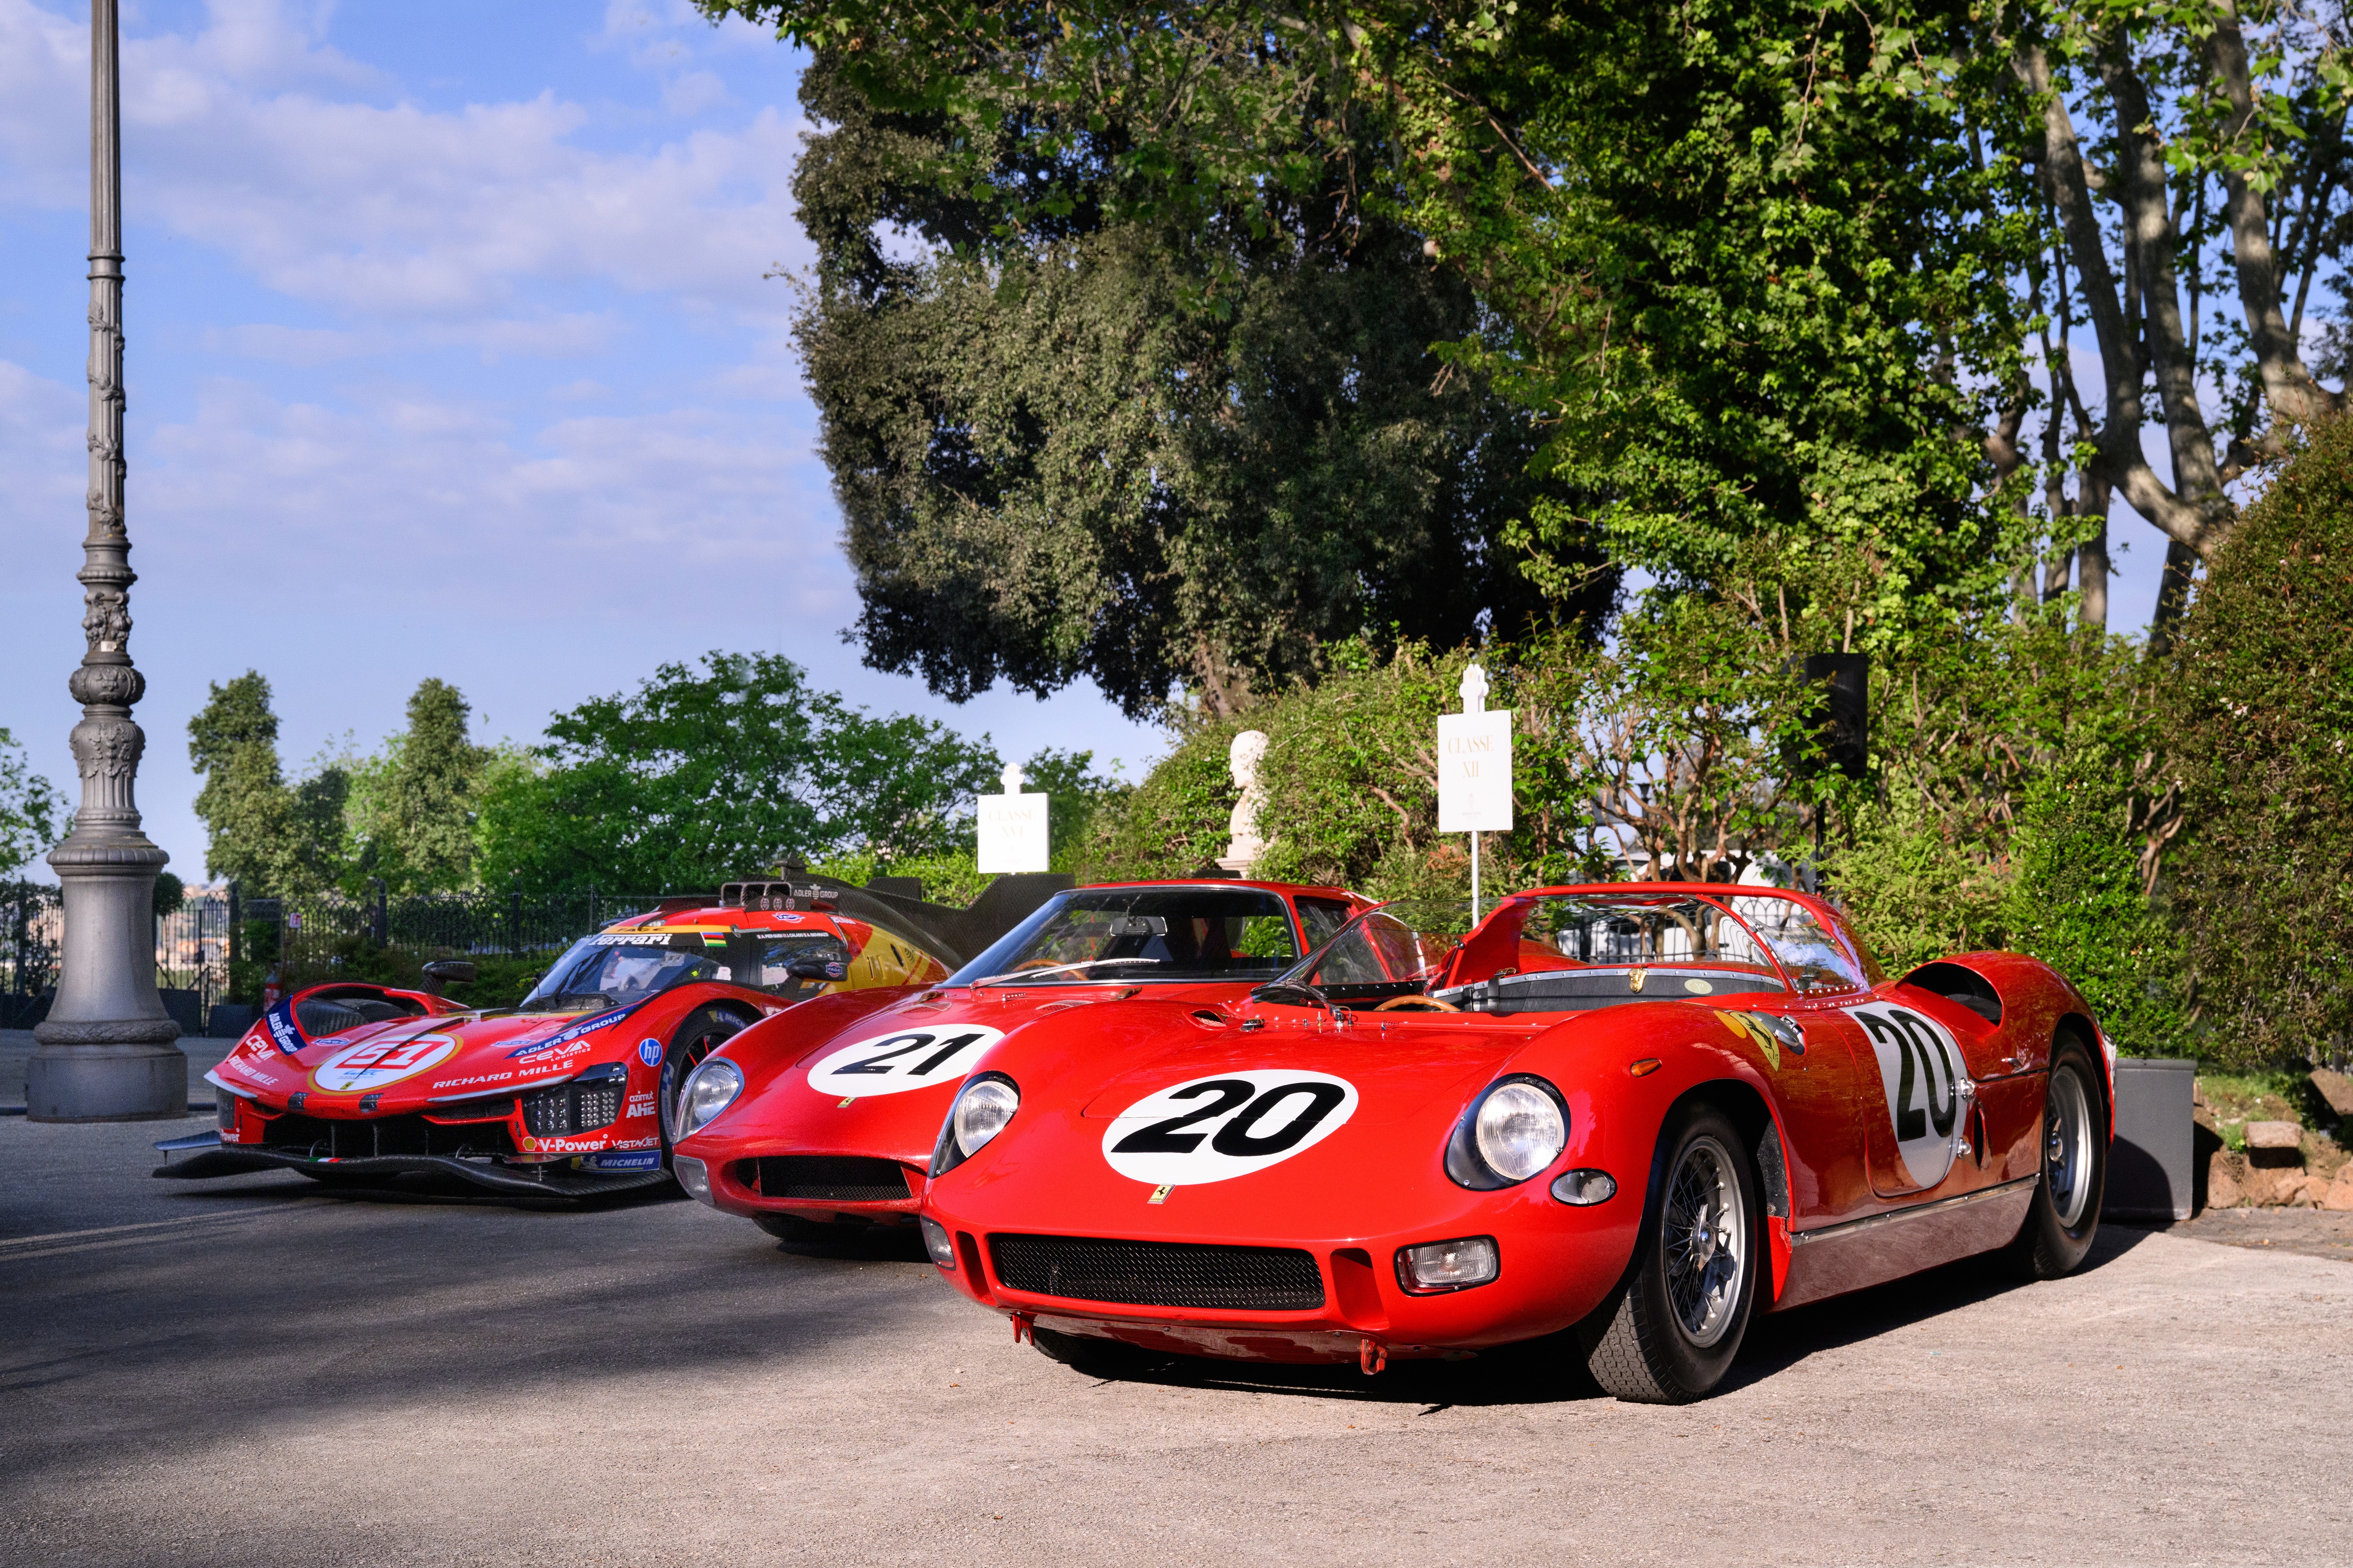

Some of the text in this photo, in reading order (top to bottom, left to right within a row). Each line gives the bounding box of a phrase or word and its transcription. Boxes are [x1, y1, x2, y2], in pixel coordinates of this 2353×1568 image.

[1448, 735, 1494, 754] CLASSE
[1463, 761, 1479, 778] XII
[988, 809, 1036, 822] CLASSE
[794, 889, 838, 899] ADLER GROUP
[588, 933, 673, 945] Ferrari
[268, 1012, 298, 1052] ADLER GROUP
[515, 1013, 626, 1055] ADLER GROUP
[344, 1042, 434, 1066] 51
[551, 1047, 591, 1062] LOGISTICS
[643, 1039, 660, 1067] hp
[831, 1033, 986, 1076] 21
[228, 1055, 257, 1076] RICHARD
[250, 1072, 279, 1085] MILLE
[433, 1060, 573, 1089] RICHARD MILLE
[1854, 1009, 1956, 1143] 20
[629, 1090, 654, 1102] azimut
[1110, 1078, 1346, 1157] 20
[538, 1139, 607, 1151] V-Power
[600, 1157, 655, 1167] MICHELIN
